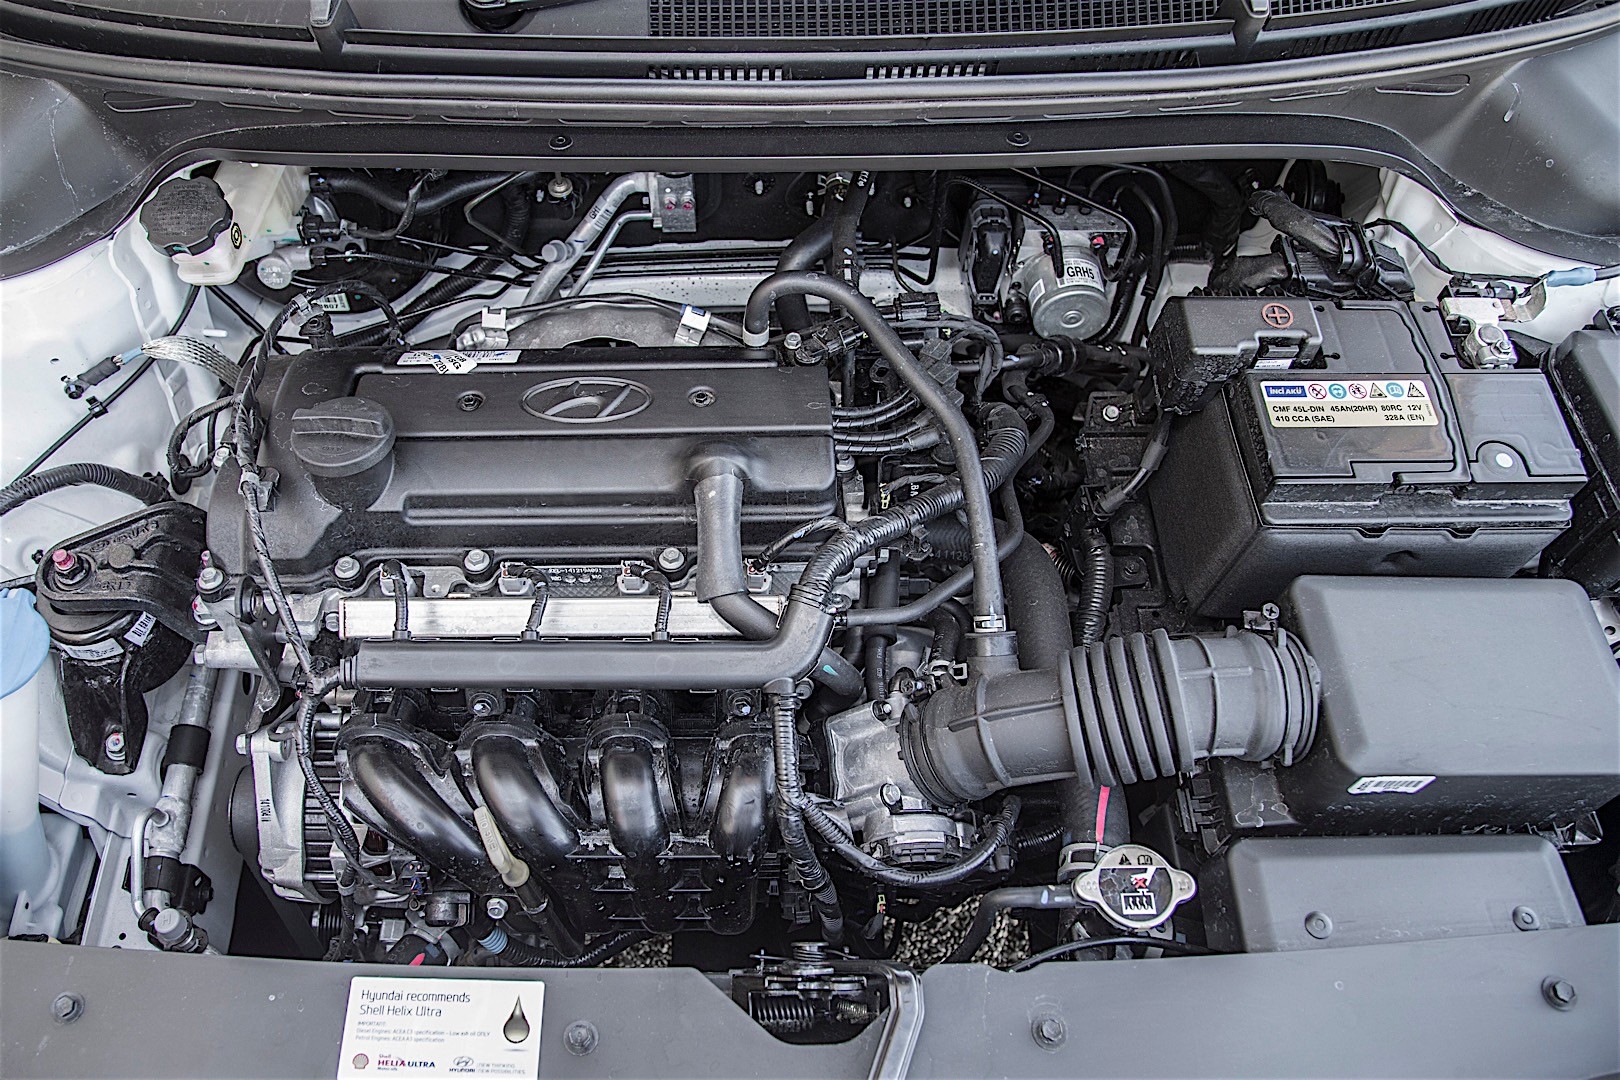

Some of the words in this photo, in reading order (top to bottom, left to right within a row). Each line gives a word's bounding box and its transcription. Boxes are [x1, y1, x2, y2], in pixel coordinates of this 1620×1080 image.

[1066, 266, 1095, 280] GRH5
[1272, 405, 1290, 413] CMF
[1292, 405, 1325, 413] 45L-DIN
[1330, 404, 1378, 413] 45Ah(20HR)
[1380, 404, 1403, 412] 80RC
[1311, 415, 1335, 423] (SAE)
[1406, 414, 1425, 422] (EN)
[360, 989, 404, 1003] Hyundai
[406, 992, 471, 1004] recommends
[359, 1004, 385, 1016] Shell
[386, 1005, 413, 1017] Helix
[415, 1005, 442, 1017] Ultra
